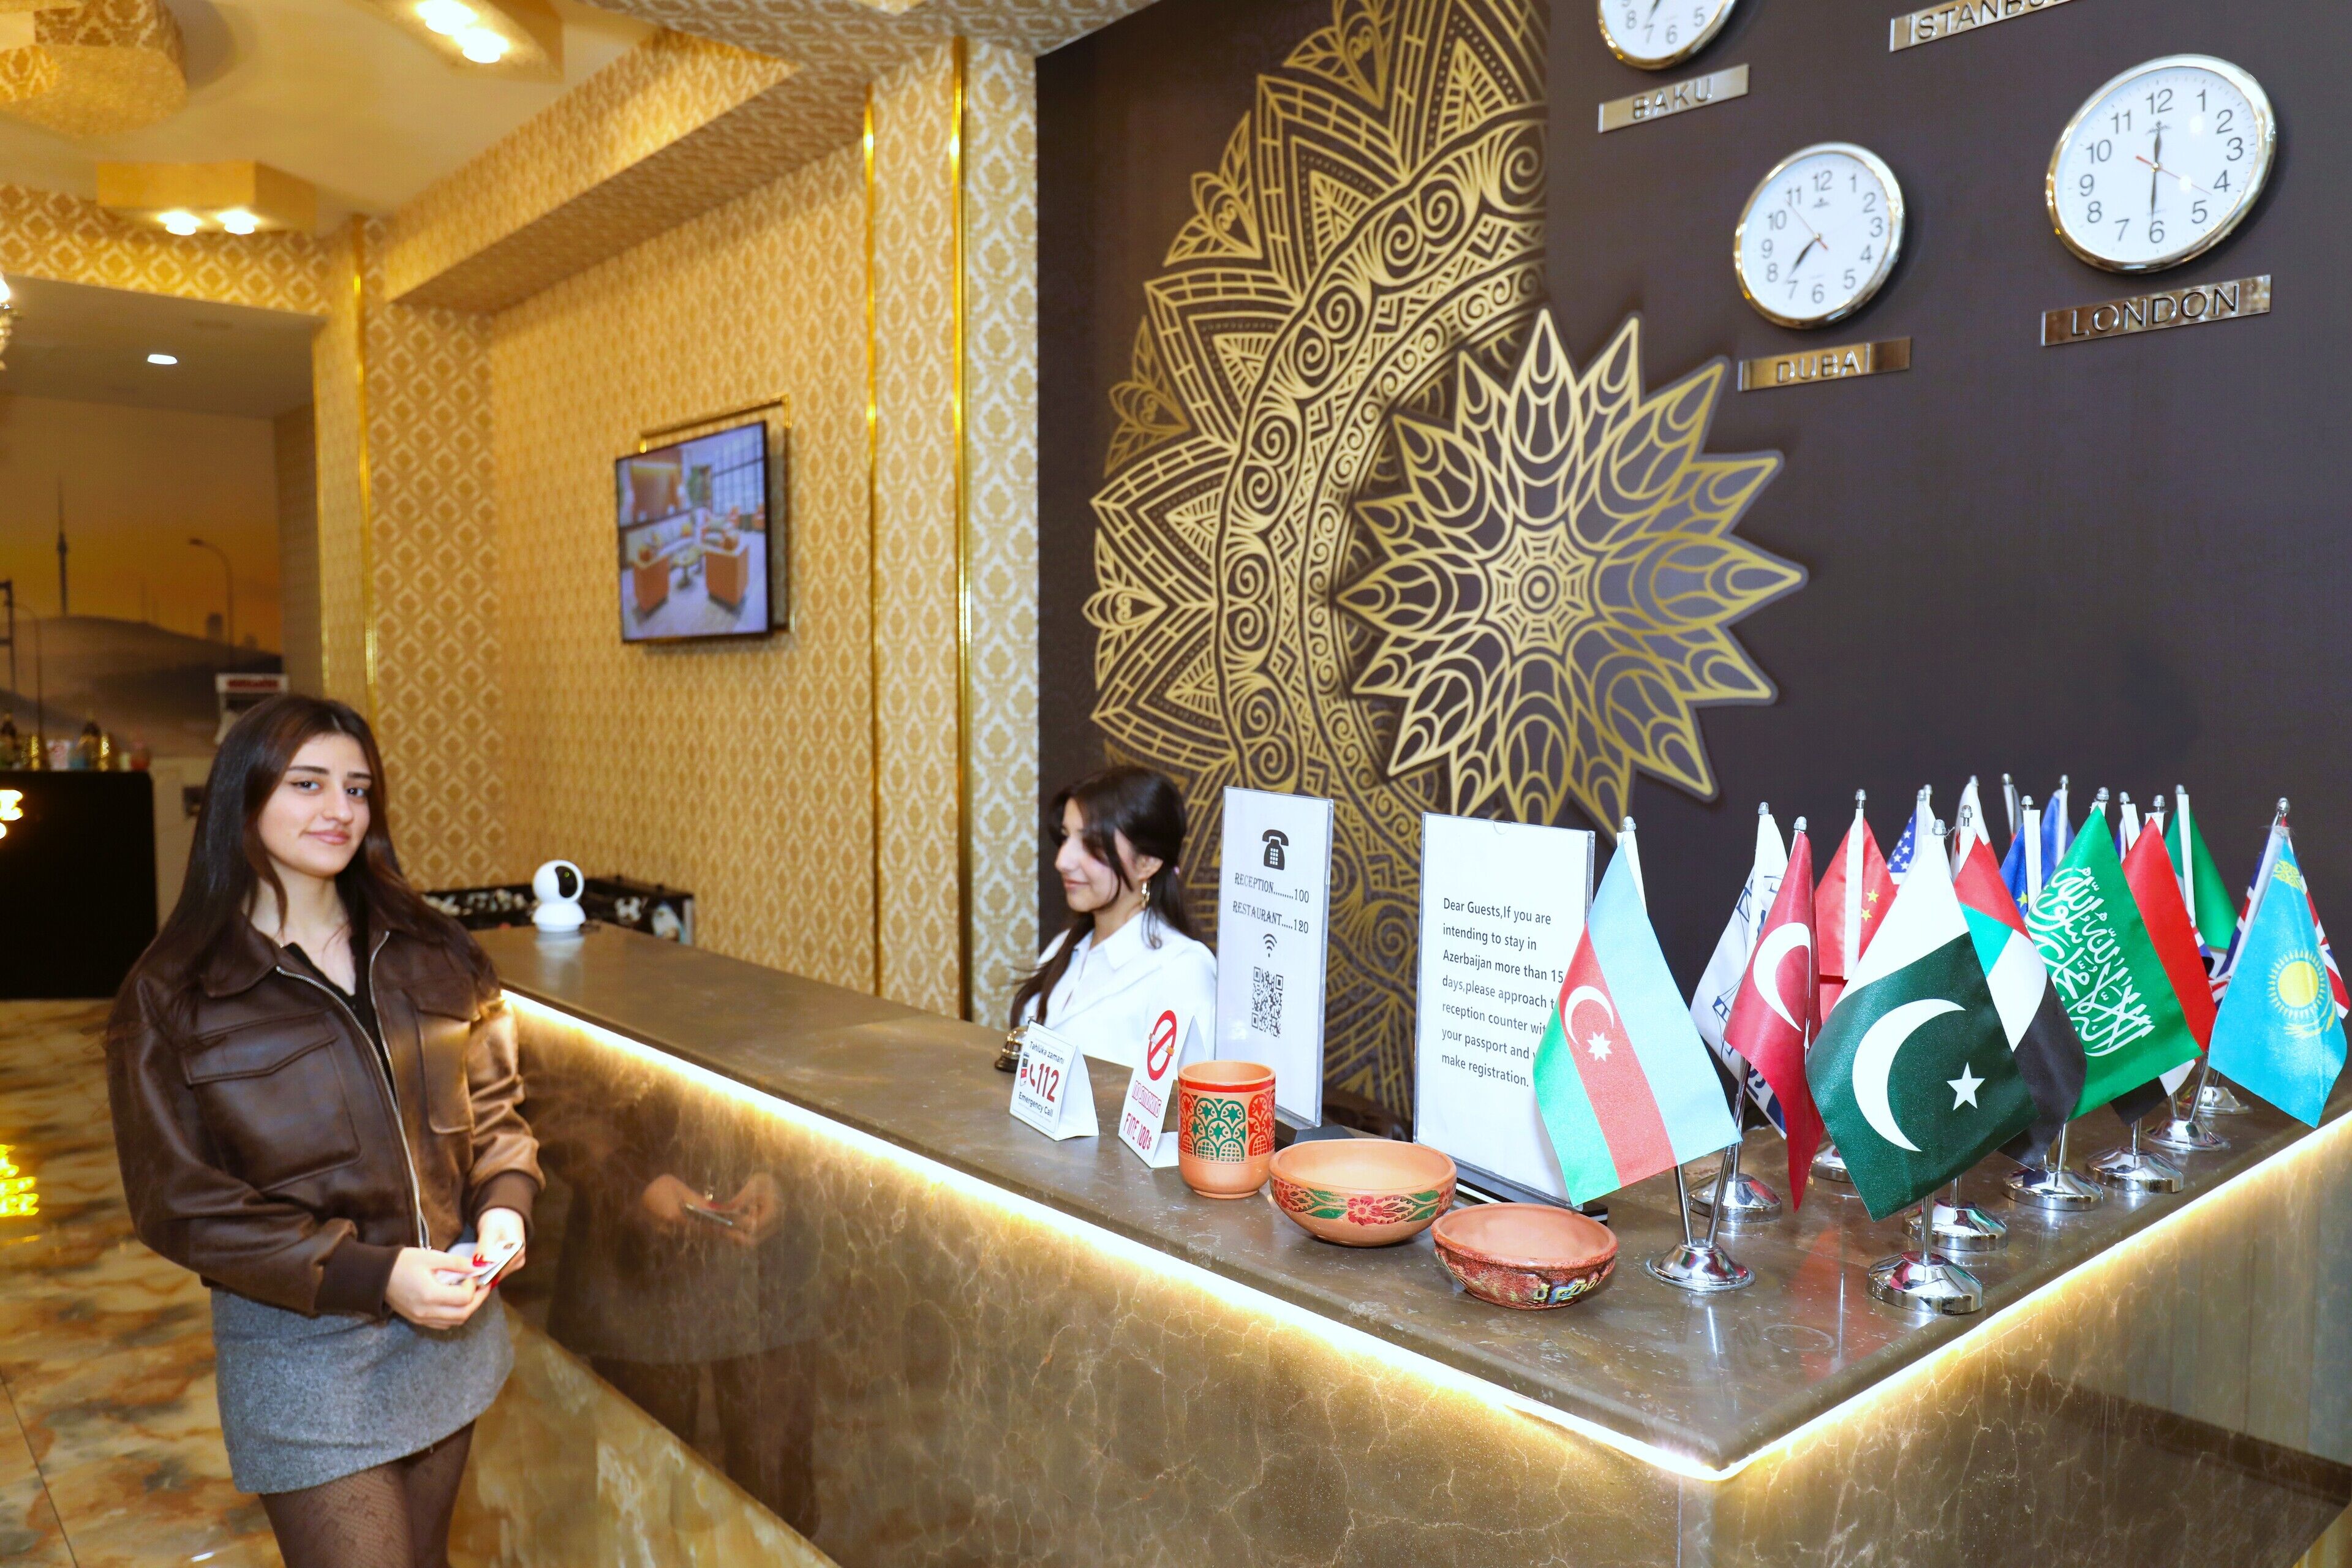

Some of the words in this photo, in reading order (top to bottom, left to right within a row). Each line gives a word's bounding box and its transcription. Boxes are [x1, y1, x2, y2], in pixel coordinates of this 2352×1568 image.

[1626, 10, 1637, 29] 8
[1694, 6, 1705, 27] 5
[1910, 0, 2048, 44] ISTANB
[1643, 24, 1654, 43] 7
[1665, 24, 1678, 44] 6
[1633, 76, 1713, 119] BAKU
[2146, 89, 2173, 115] 12
[2196, 89, 2206, 112] 1
[2111, 109, 2131, 134] 11
[2216, 109, 2233, 134] 2
[2086, 139, 2111, 164] 10
[2226, 137, 2244, 161] 3
[1812, 170, 1833, 192] 12
[1849, 173, 1857, 193] 1
[2079, 174, 2095, 197] 9
[2214, 170, 2231, 192] 4
[1786, 186, 1801, 205] 11
[1863, 192, 1876, 213] 2
[1768, 210, 1787, 231] 10
[2087, 201, 2102, 223] 8
[2192, 200, 2207, 224] 5
[1870, 217, 1883, 238] 3
[2114, 218, 2130, 241] 7
[2149, 221, 2165, 243] 6
[1761, 239, 1773, 259] 9
[1860, 244, 1872, 263] 4
[1766, 263, 1778, 282] 8
[1843, 269, 1856, 289] 5
[1785, 280, 1798, 300] 7
[1812, 284, 1824, 304] 6
[2071, 283, 2239, 336] LONDON
[1777, 342, 1871, 383] DUBAI
[1444, 898, 1464, 911] Dear
[1514, 911, 1532, 923] you
[1535, 913, 1551, 925] are
[1443, 923, 1488, 945] intending
[1491, 932, 1501, 944] to
[1505, 935, 1524, 951] stay
[1528, 937, 1536, 950] in
[1443, 949, 1491, 970] Azerbaijan
[1495, 962, 1520, 975] more
[1524, 965, 1547, 980] than
[1551, 970, 1563, 983] 15
[1499, 989, 1547, 1008] approach
[1442, 1003, 1485, 1021] reception
[1488, 1014, 1528, 1031] counter
[1531, 1022, 1547, 1035] wit
[1442, 1028, 1462, 1041] your
[1465, 1035, 1507, 1054] passport
[1510, 1047, 1529, 1060] and
[1442, 1054, 1466, 1069] make
[1469, 1062, 1529, 1087] registration.
[1036, 1063, 1059, 1102] 112
[1019, 1091, 1043, 1113] Emergency
[1044, 1106, 1054, 1117] Call
[1123, 1112, 1140, 1140] FINE
